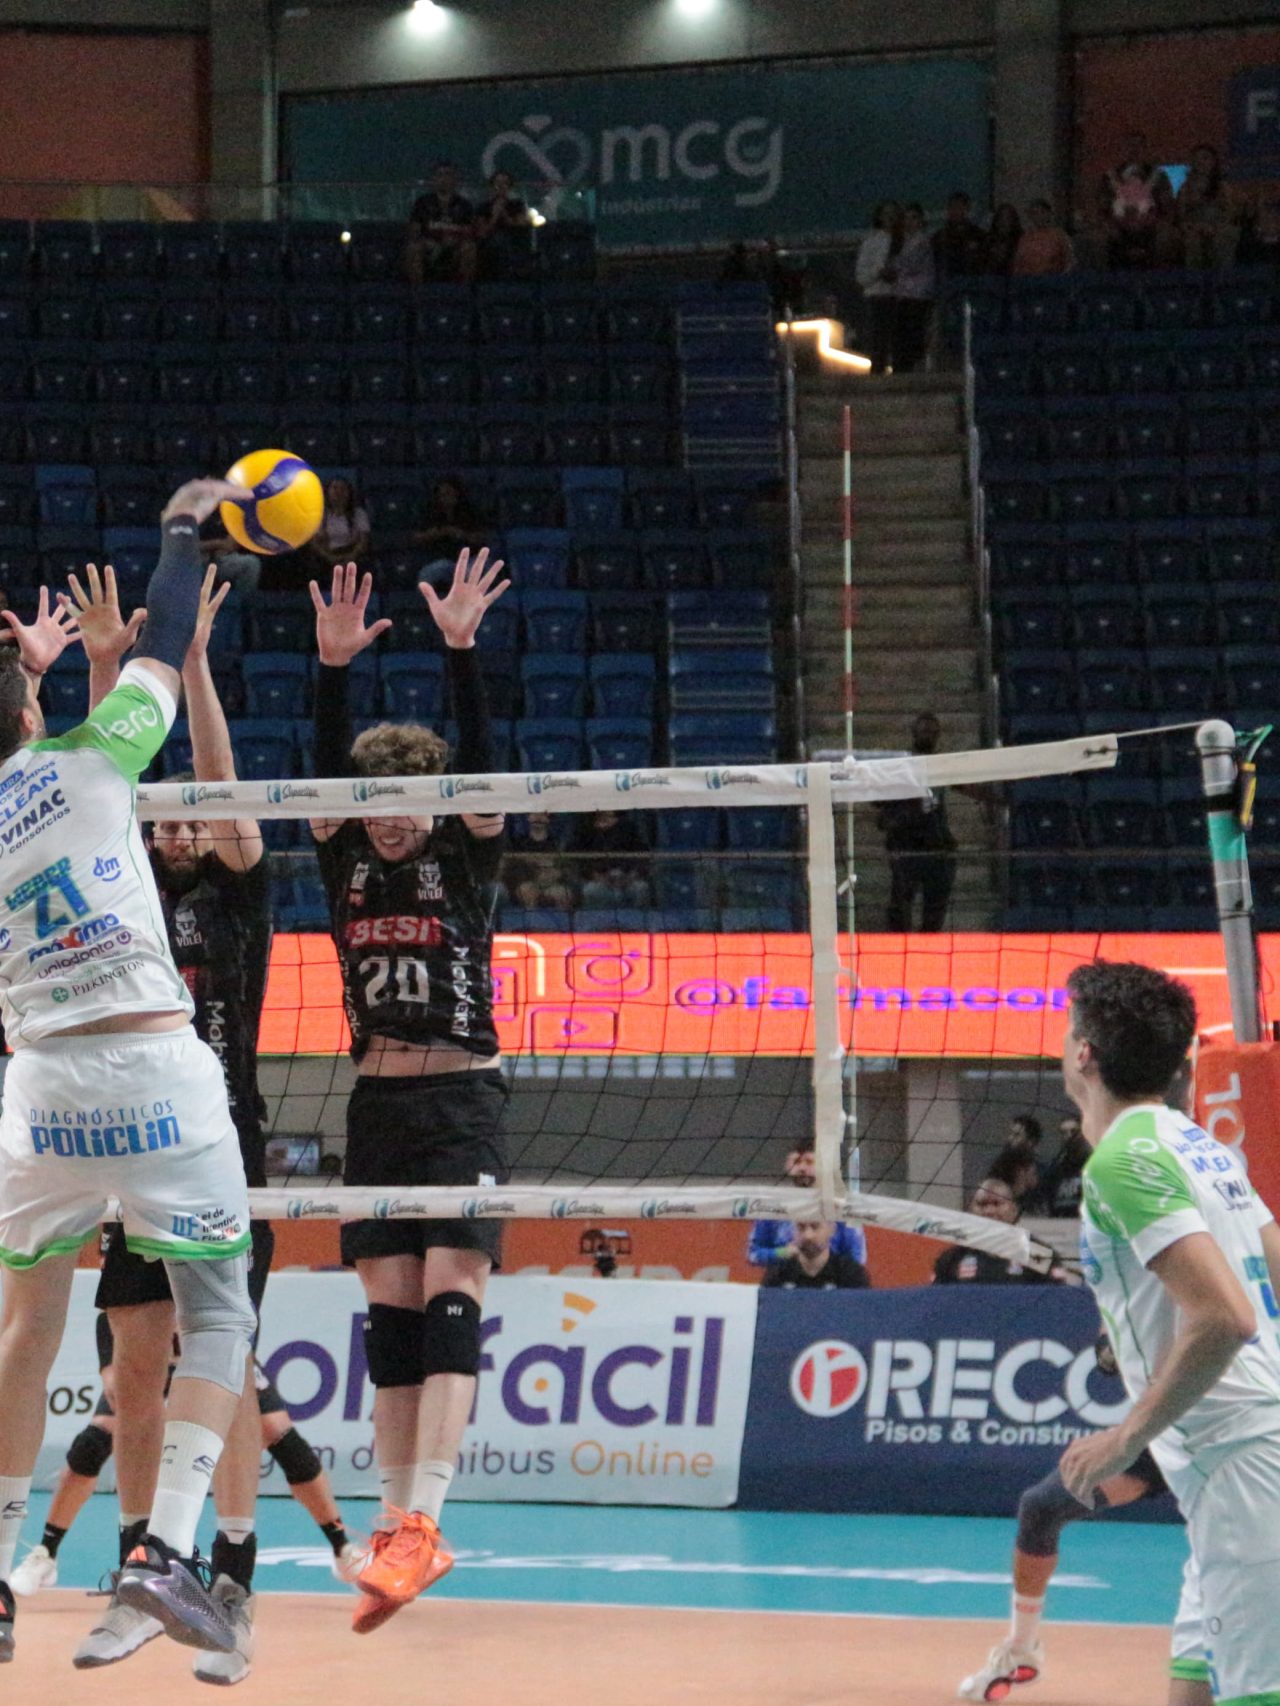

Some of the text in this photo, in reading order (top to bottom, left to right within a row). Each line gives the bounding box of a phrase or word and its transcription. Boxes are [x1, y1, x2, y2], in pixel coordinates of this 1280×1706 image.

[600, 116, 784, 207] mcg
[0, 788, 66, 845] VINAC
[9, 806, 71, 854] consórcios
[352, 915, 431, 945] SESI
[358, 955, 431, 1009] 20
[675, 976, 1070, 1016] @famaco
[29, 1098, 174, 1126] DIAGNÓSTICOS
[865, 1419, 1100, 1446] Pisos & Constru
[571, 1439, 715, 1478] Online
